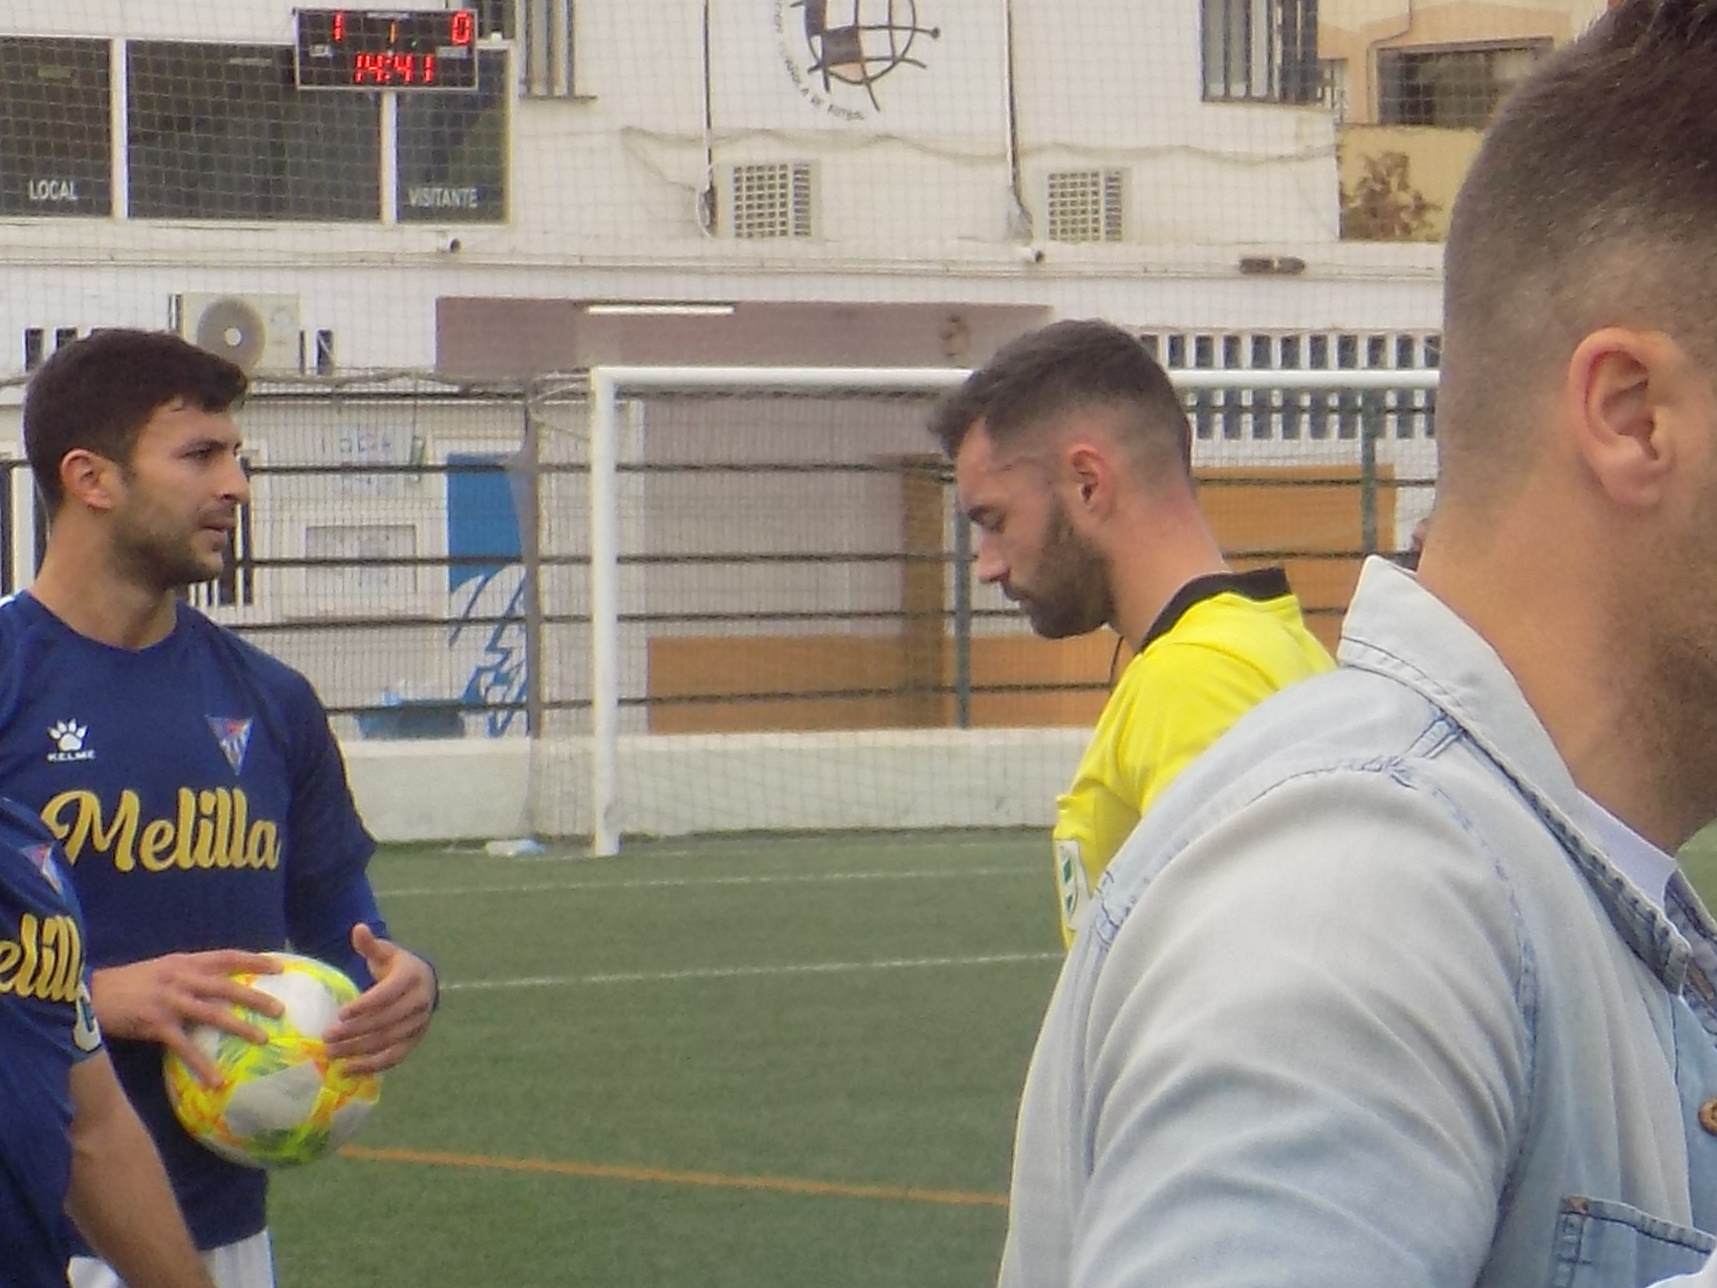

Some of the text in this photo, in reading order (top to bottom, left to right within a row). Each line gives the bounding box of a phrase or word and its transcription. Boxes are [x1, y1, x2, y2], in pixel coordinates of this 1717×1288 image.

[451, 9, 471, 46] 0
[354, 53, 434, 82] 14:41
[28, 180, 77, 201] LOCAL
[408, 187, 478, 208] VISITANTE
[39, 786, 281, 872] Melilla
